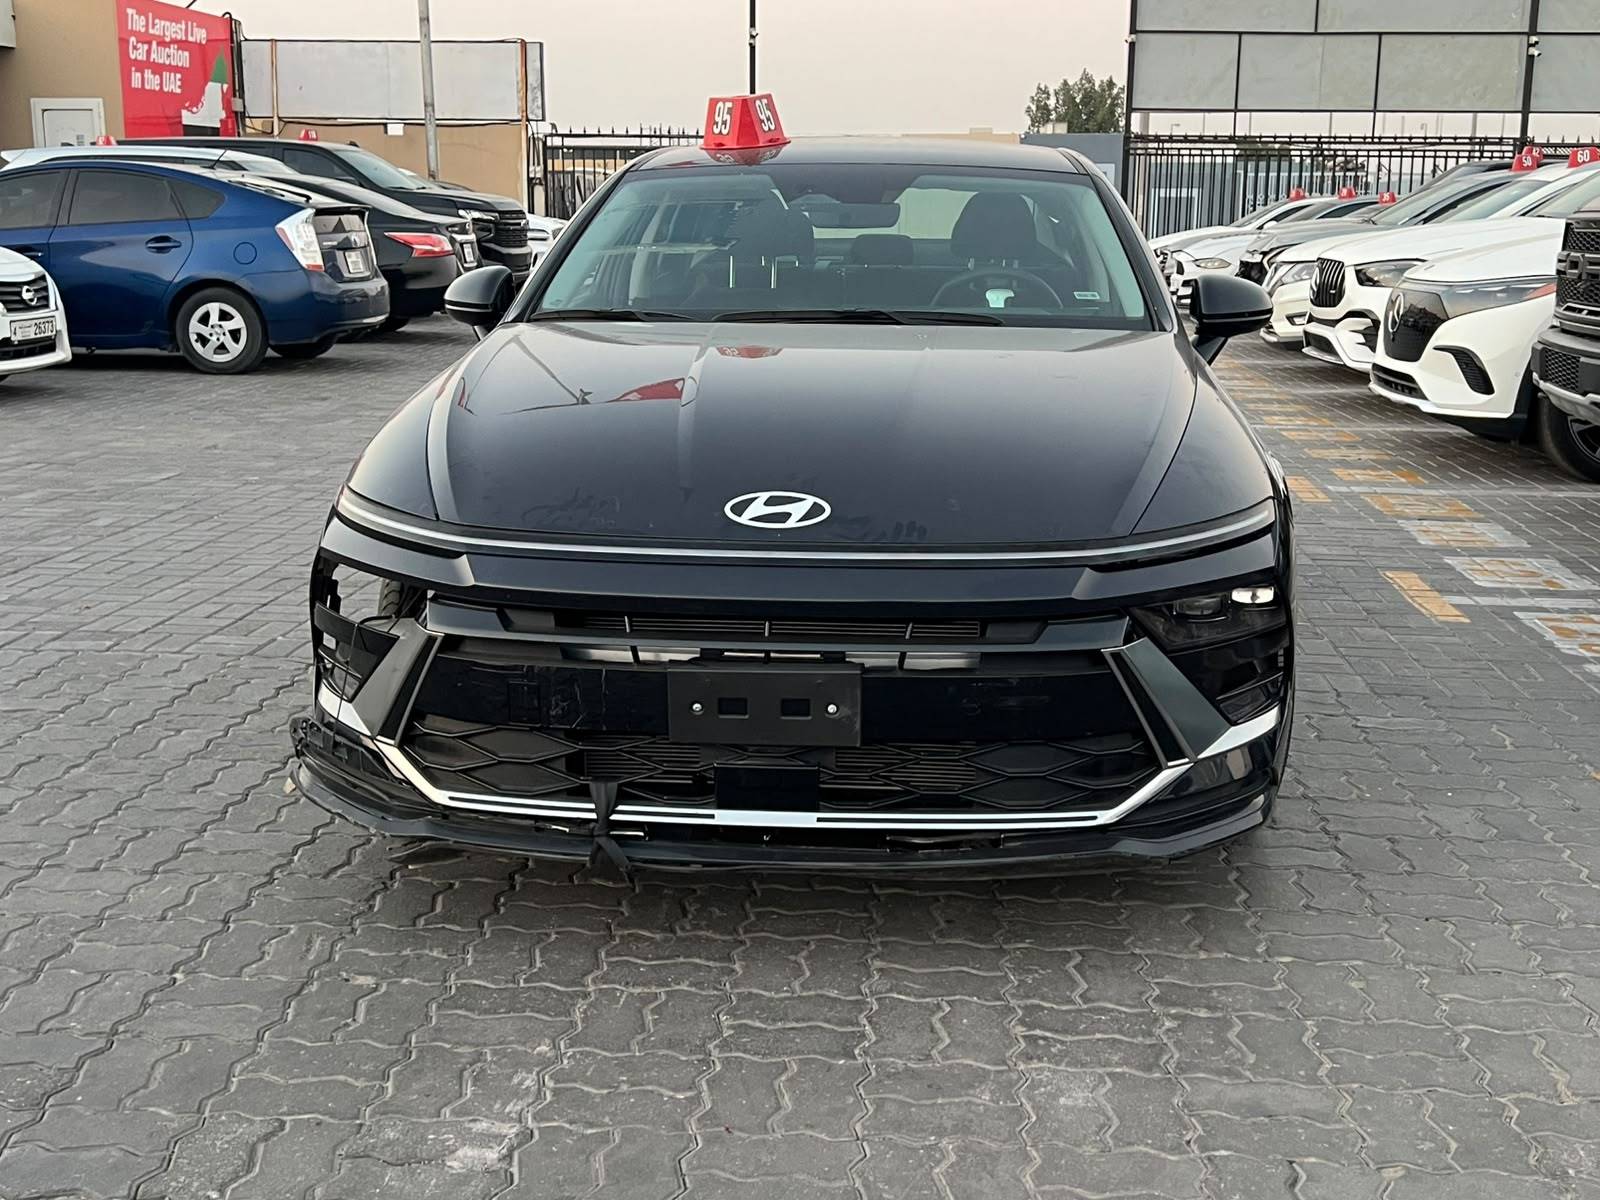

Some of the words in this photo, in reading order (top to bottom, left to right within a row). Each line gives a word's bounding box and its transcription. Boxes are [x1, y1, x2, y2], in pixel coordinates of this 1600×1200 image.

[126, 8, 146, 32] The
[148, 12, 186, 42] Largest
[187, 21, 207, 44] Live
[128, 36, 149, 61] Car
[150, 40, 190, 68] Auction
[131, 66, 142, 88] in
[143, 69, 161, 91] the
[162, 71, 182, 93] UAE
[712, 101, 733, 135] 95
[755, 98, 776, 132] 95
[1522, 155, 1532, 167] 50
[1577, 149, 1590, 163] 60
[33, 320, 54, 336] 26373
